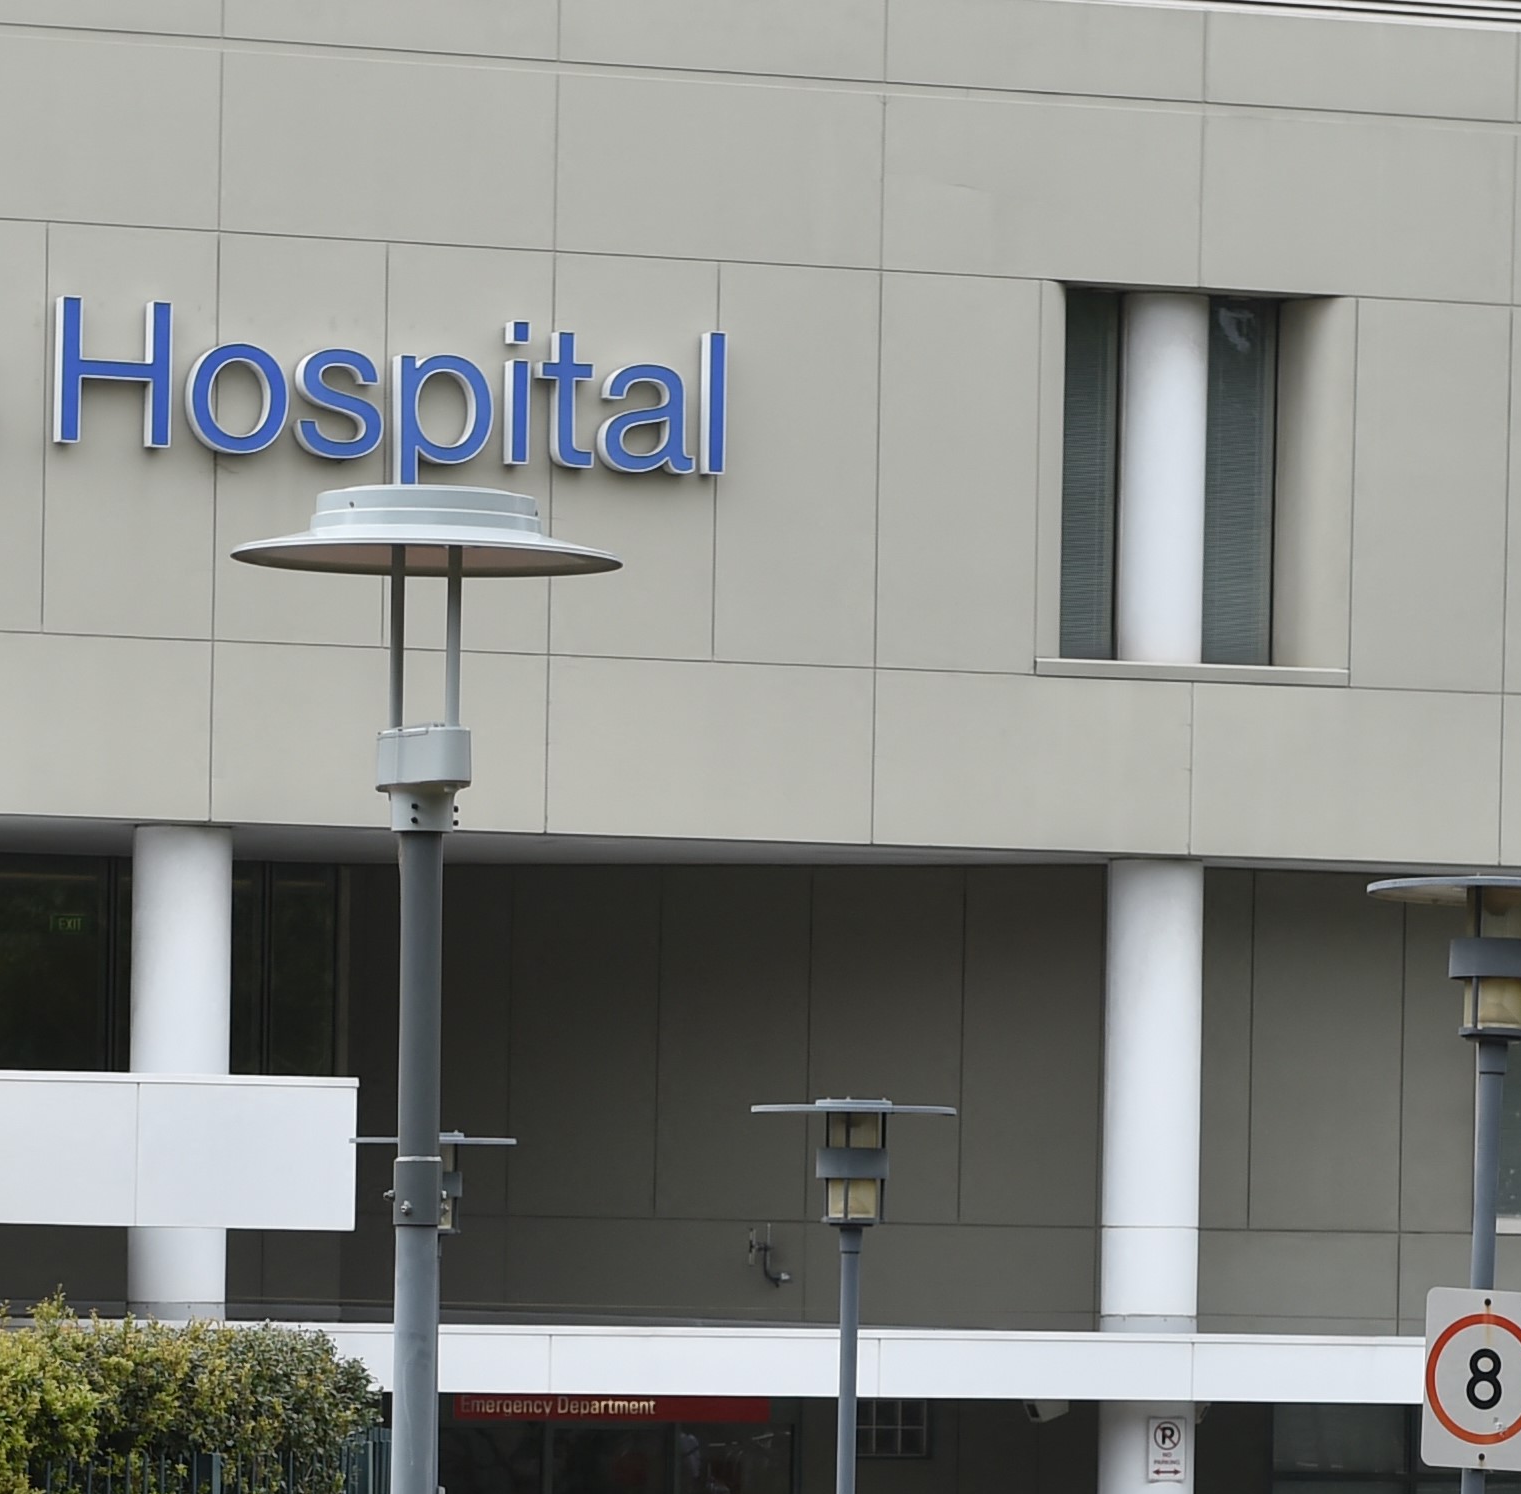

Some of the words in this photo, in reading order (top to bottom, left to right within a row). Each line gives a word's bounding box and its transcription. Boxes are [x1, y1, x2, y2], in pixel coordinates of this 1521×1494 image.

[53, 293, 726, 486] Hospital
[460, 1395, 553, 1417] Emergency
[557, 1396, 656, 1416] Department
[1466, 1348, 1502, 1411] 8
